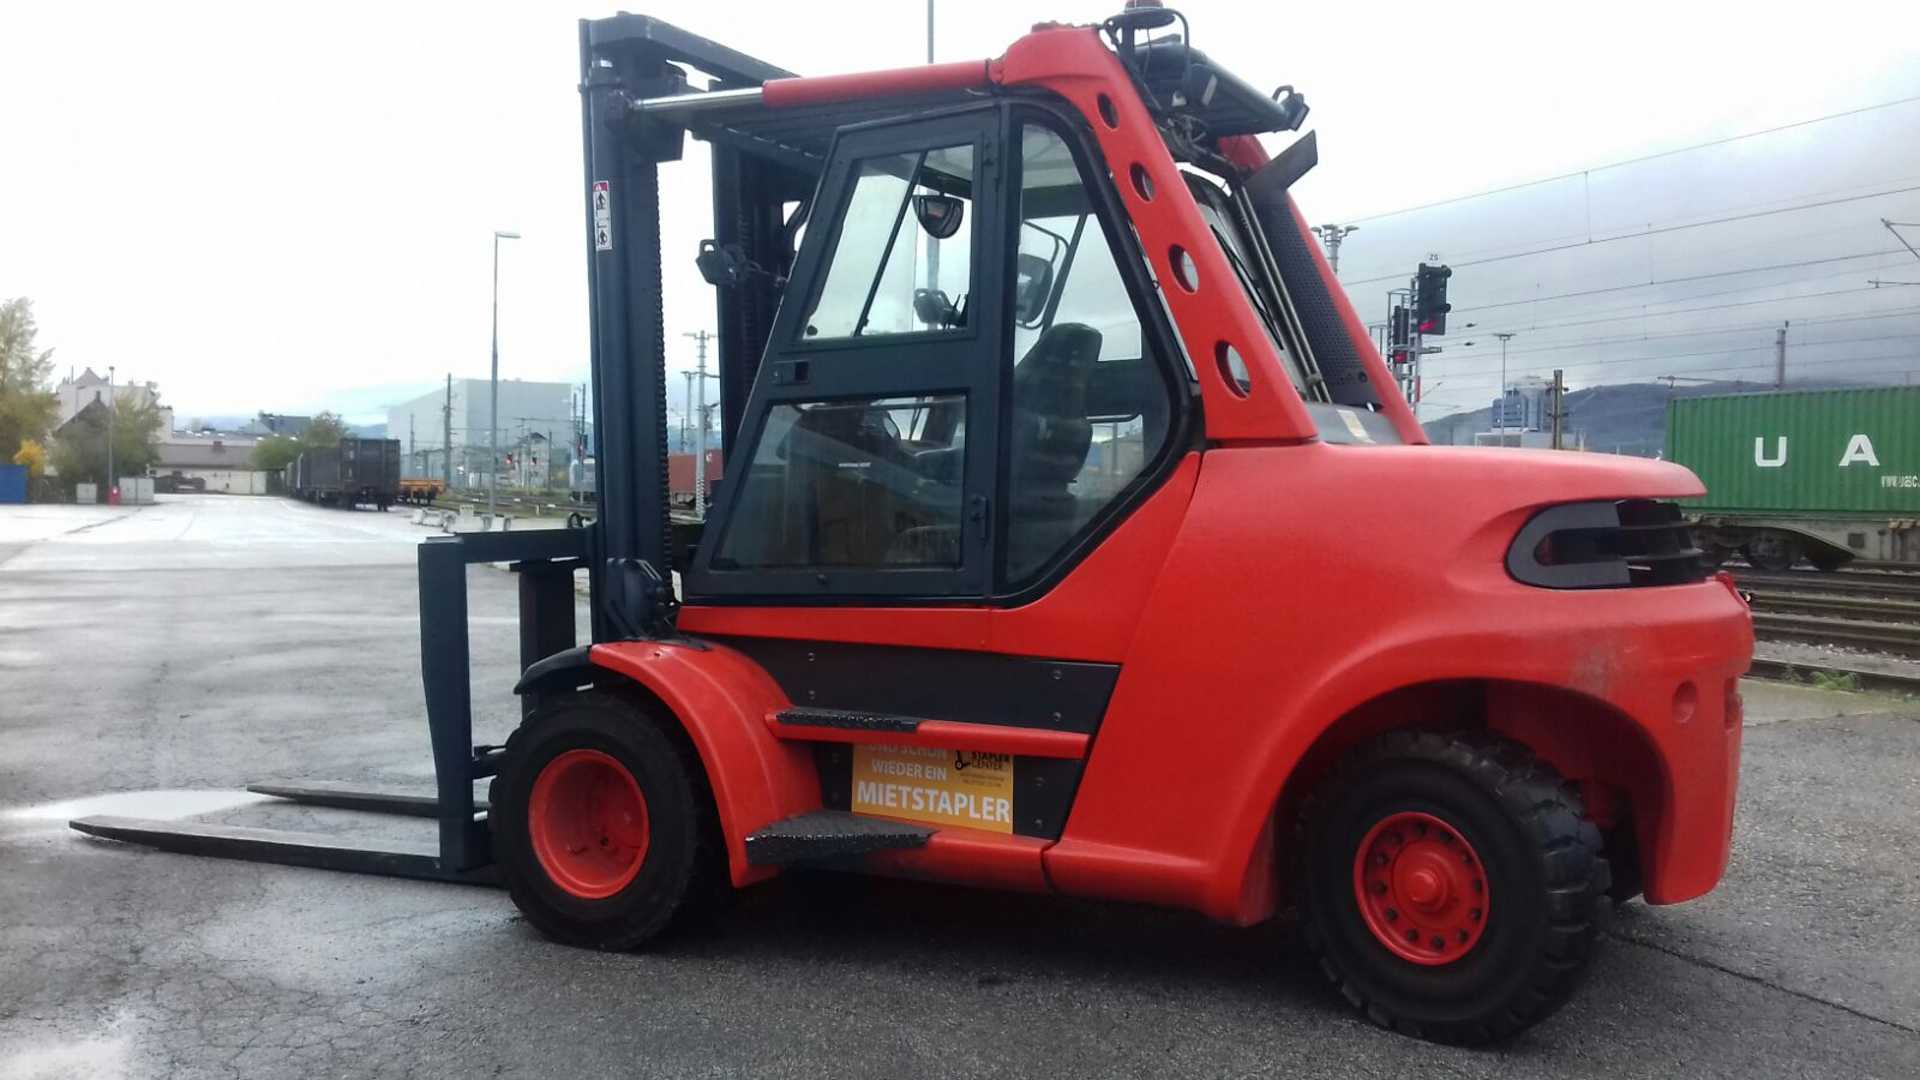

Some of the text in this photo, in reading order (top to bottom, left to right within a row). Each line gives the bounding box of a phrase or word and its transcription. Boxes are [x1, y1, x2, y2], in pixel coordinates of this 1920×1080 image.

[1755, 434, 1880, 467] U A
[872, 758, 922, 778] WIEDER
[926, 766, 947, 780] EIN
[857, 781, 1010, 822] MIETSTAPLER
